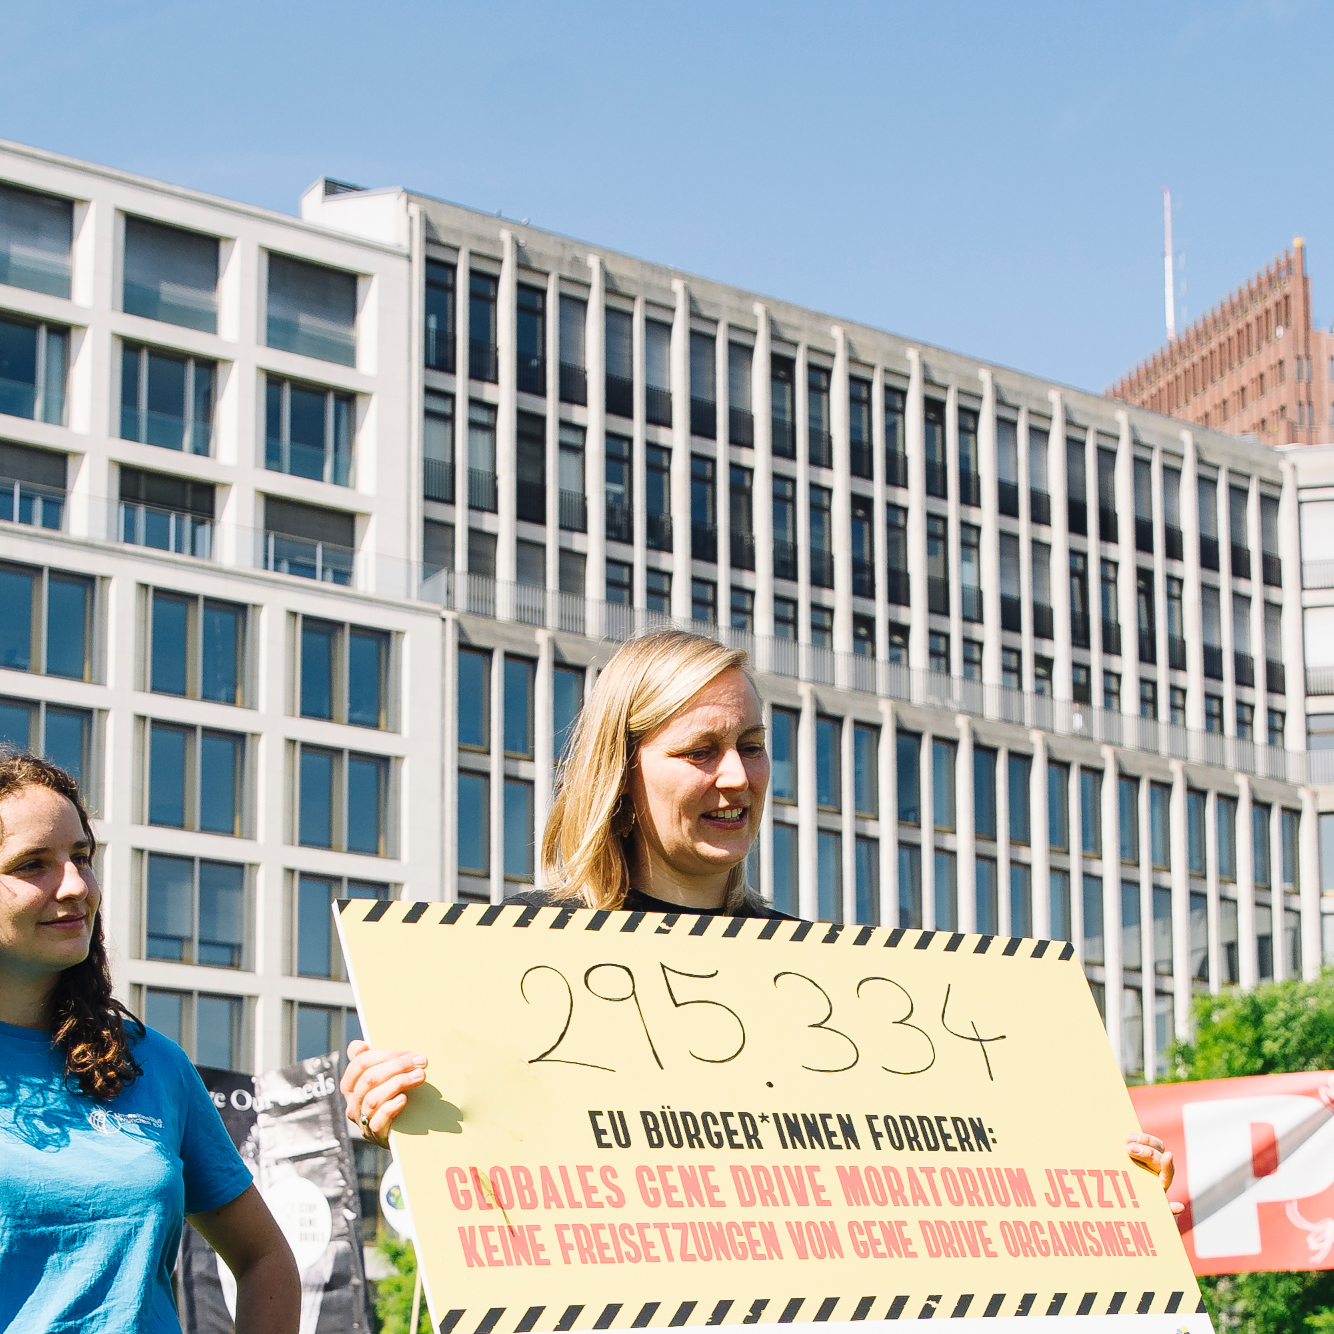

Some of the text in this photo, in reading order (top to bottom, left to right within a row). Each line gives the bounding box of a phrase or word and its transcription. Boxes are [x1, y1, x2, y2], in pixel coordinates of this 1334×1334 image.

[520, 962, 1007, 1087] 295.334
[588, 1110, 632, 1149] EU
[865, 1114, 998, 1152] FORDERN:
[445, 1165, 1140, 1210] GLOBALES GENE DRIVE MORATORIUM JETZT!
[457, 1220, 1158, 1267] KEINE FREISETZUNGEN VON GENE DRIVE ORGANISMEN!
